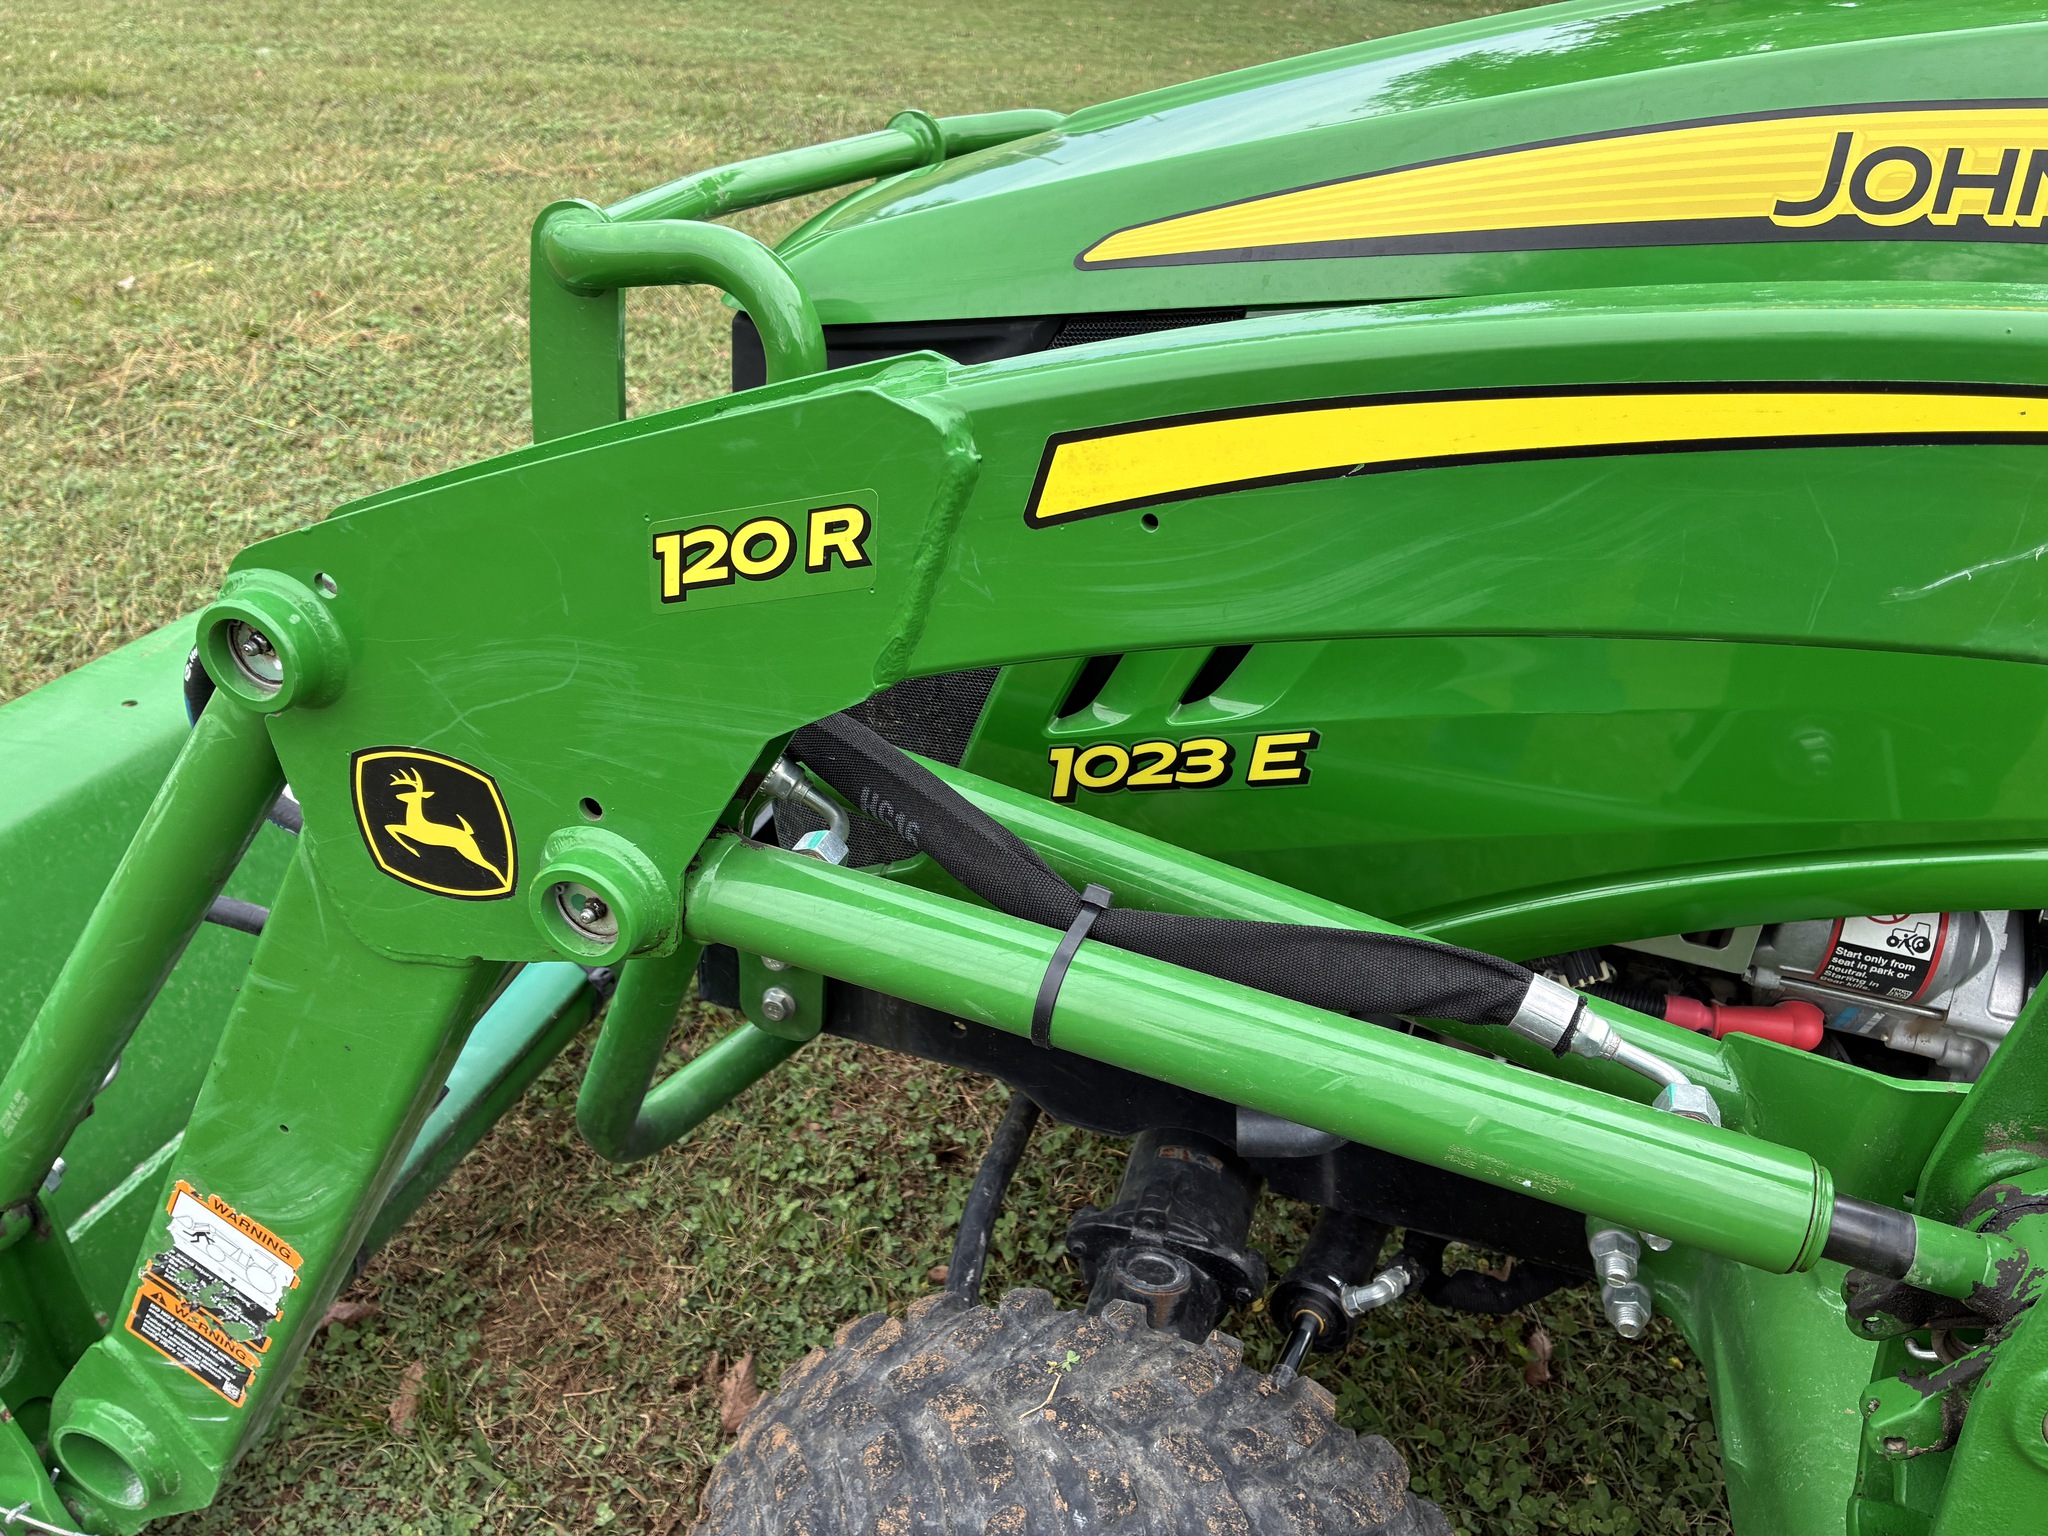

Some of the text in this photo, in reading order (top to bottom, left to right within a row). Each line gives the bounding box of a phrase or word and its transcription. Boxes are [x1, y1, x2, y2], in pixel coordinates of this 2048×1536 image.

[653, 503, 873, 604] 120 R
[1048, 731, 1321, 803] 1023 E
[1827, 964, 1868, 979] neutral.
[1831, 955, 1910, 980] seat in park or
[1835, 946, 1916, 972] Start only from
[1868, 979, 1880, 988] in
[214, 1199, 292, 1260] WARNING
